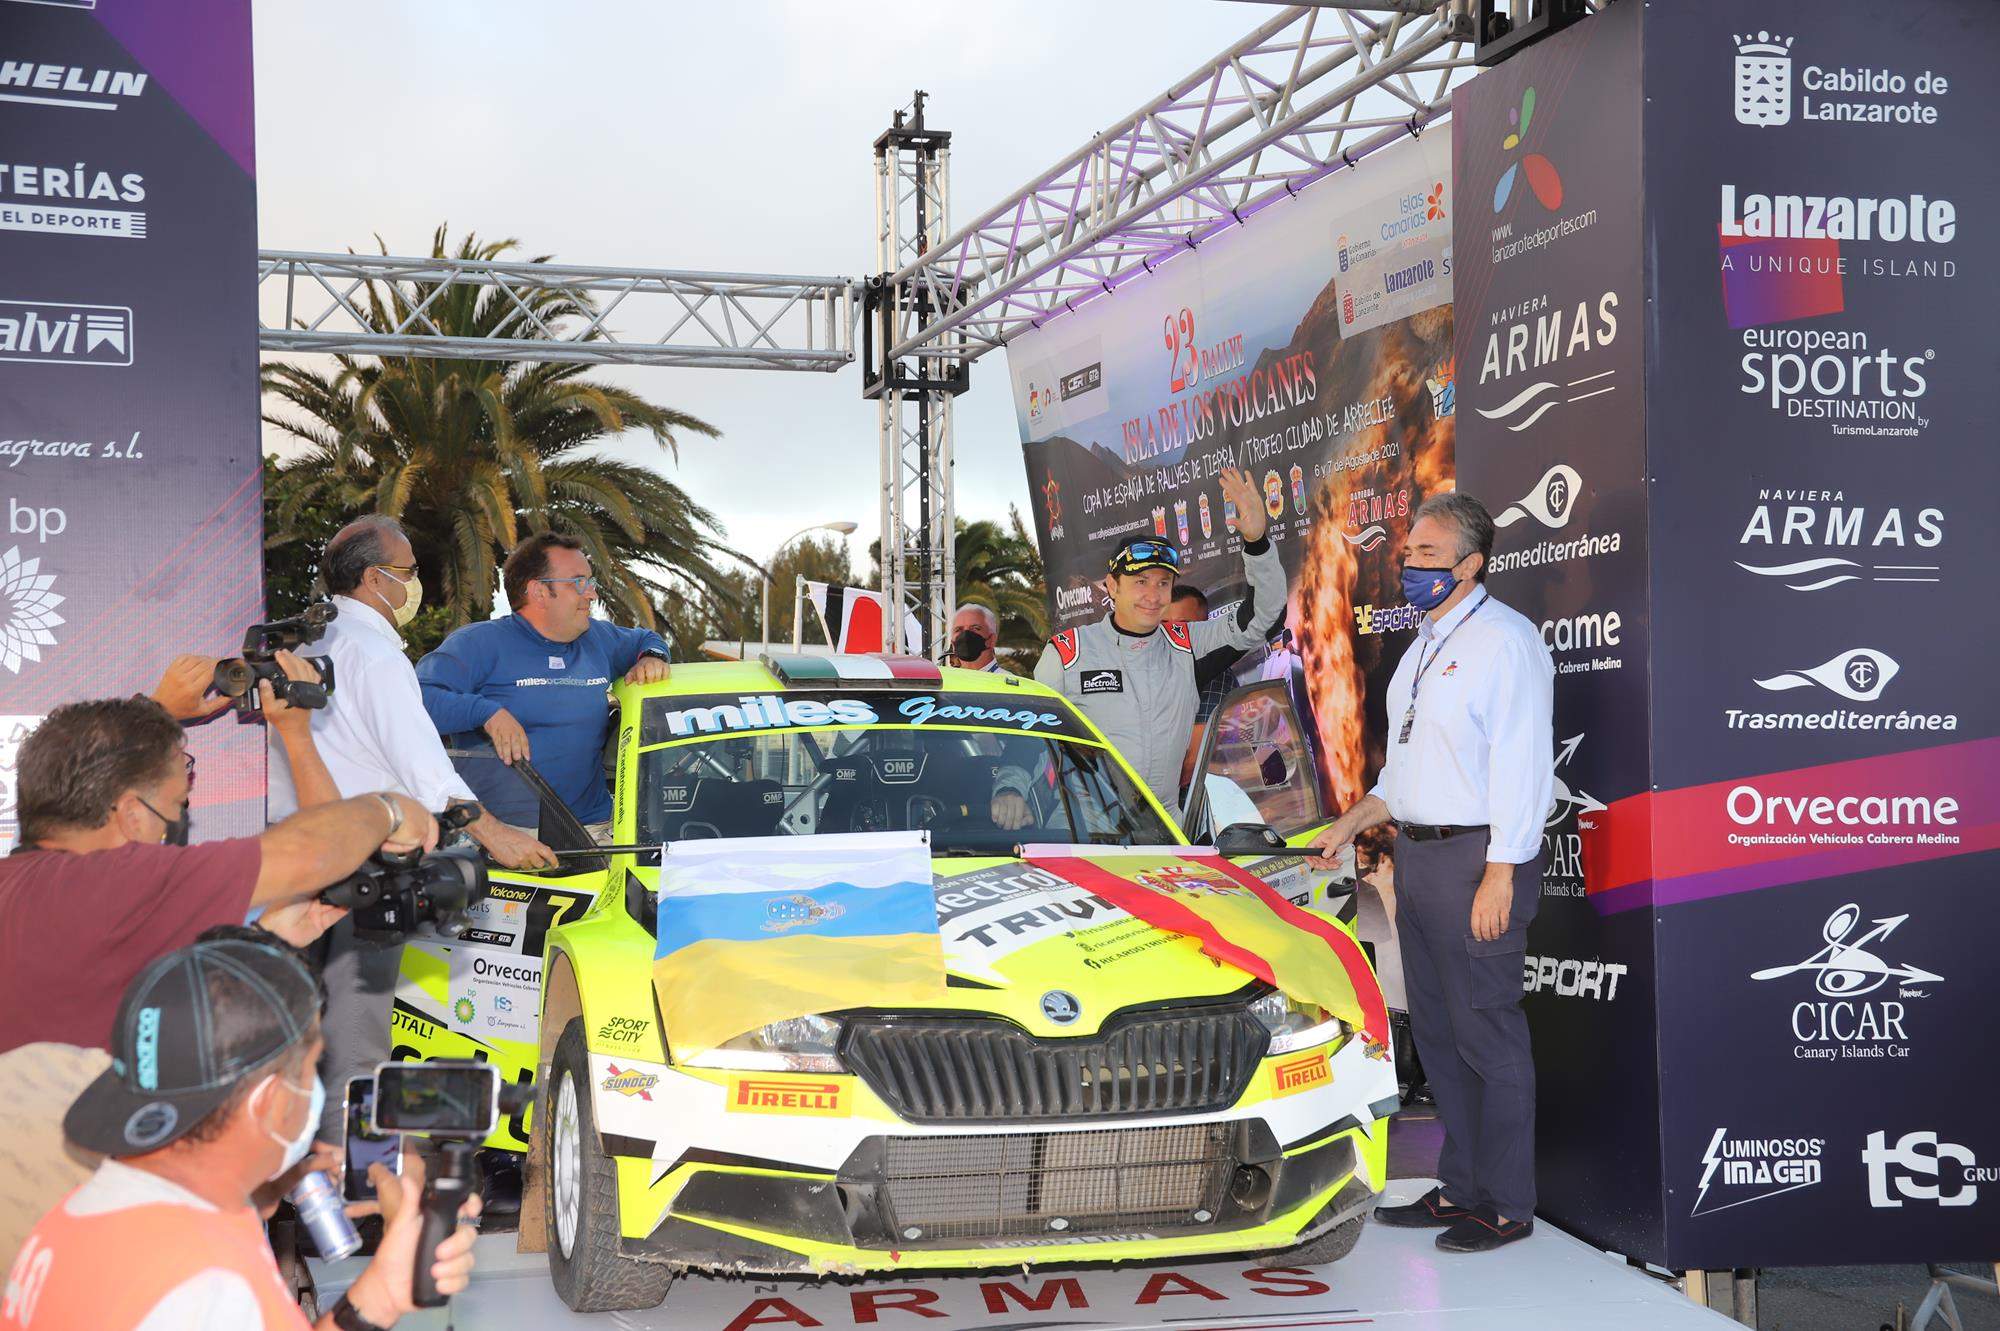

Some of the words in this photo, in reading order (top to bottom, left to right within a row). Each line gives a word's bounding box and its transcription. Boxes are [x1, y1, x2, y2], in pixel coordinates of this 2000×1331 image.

[0, 61, 148, 96] HELIN
[1803, 66, 1906, 94] Cabildo
[1914, 70, 1949, 95] de
[1803, 96, 1938, 125] Lanzarote
[1400, 192, 1425, 214] Islas
[1721, 184, 1956, 243] Lanzarote
[32, 212, 122, 230] DEPORTE
[1381, 210, 1427, 241] Canarias
[1491, 222, 1513, 244] www.
[1491, 208, 1598, 264] lanzarotedeportes.com
[1384, 259, 1434, 294] Lanzarote
[1721, 255, 1734, 271] A
[1750, 256, 1847, 275] UNIQUE
[1863, 259, 1956, 278] ISLAND
[1491, 294, 1548, 326] NAVIERA
[1164, 306, 1200, 394] 23
[1479, 291, 1619, 385] ARMAS
[1743, 328, 1868, 355] european
[1200, 334, 1245, 380] RALLYE
[1741, 347, 1927, 409] sports
[1121, 415, 1160, 466] ISLA
[1158, 401, 1182, 453] DE
[1181, 390, 1215, 444] LOS
[1215, 350, 1317, 431] VOLCANES
[1787, 399, 1916, 420] DESTINATION
[1917, 416, 1930, 428] by
[101, 431, 143, 459] s.l.
[1832, 424, 1919, 437] TurismoLanzarote
[1083, 488, 1102, 516] COPA
[1102, 489, 1113, 507] DE
[1114, 474, 1145, 508] ESPAÑA
[1144, 474, 1156, 495] DE
[1156, 461, 1190, 494] RALLYES
[1190, 459, 1201, 480] DE
[1203, 445, 1236, 480] TIERRA
[1246, 432, 1283, 466] TROFEO
[1285, 416, 1324, 450] CIUDAD
[1326, 413, 1339, 438] DE
[1343, 396, 1396, 433] ARRECIFE
[1314, 465, 1320, 477] 6
[1326, 461, 1332, 475] 7
[1335, 459, 1344, 471] de
[1344, 450, 1370, 471] Agosto
[1370, 449, 1380, 462] de
[1381, 441, 1401, 460] 2021
[1348, 489, 1408, 527] ARMAS
[1759, 489, 1844, 502] NAVIERA
[9, 497, 67, 543] bp
[1740, 505, 1945, 547] ARMAS
[1488, 532, 1621, 574] asmediterránea
[1056, 586, 1093, 610] Orvecame
[1541, 610, 1622, 652] came
[1559, 661, 1589, 674] Cabrera
[1591, 656, 1622, 670] Medina
[665, 695, 879, 735] miles
[898, 697, 1063, 730] Garage
[1725, 708, 1958, 730] Trasmediterránea
[836, 770, 856, 778] OMP
[884, 761, 915, 774] OMP
[763, 793, 783, 803] OMP
[1726, 785, 1960, 826] Orvecame
[1728, 833, 1806, 847] Organización
[1810, 833, 1864, 844] Vehículos
[1867, 834, 1914, 844] Cabrera
[1917, 834, 1960, 844] Medina
[1543, 881, 1570, 897] Islands
[1571, 882, 1586, 897] Car
[546, 895, 576, 931] 7
[1523, 954, 1628, 1001] SPORT
[608, 1017, 650, 1031] SPORT
[1792, 1001, 1908, 1042] CICAR
[613, 1030, 644, 1043] CITY
[1794, 1045, 1838, 1061] Canary
[1842, 1045, 1884, 1058] Islands
[1887, 1044, 1910, 1058] Car
[606, 1076, 655, 1089] SUNOCO
[1275, 1055, 1327, 1090] PIRELLI
[738, 1080, 840, 1109] PIRELLI
[1723, 1159, 1822, 1185] IMAGEN
[1963, 1167, 2000, 1182] GRU
[722, 1267, 1330, 1331] ARMAS
